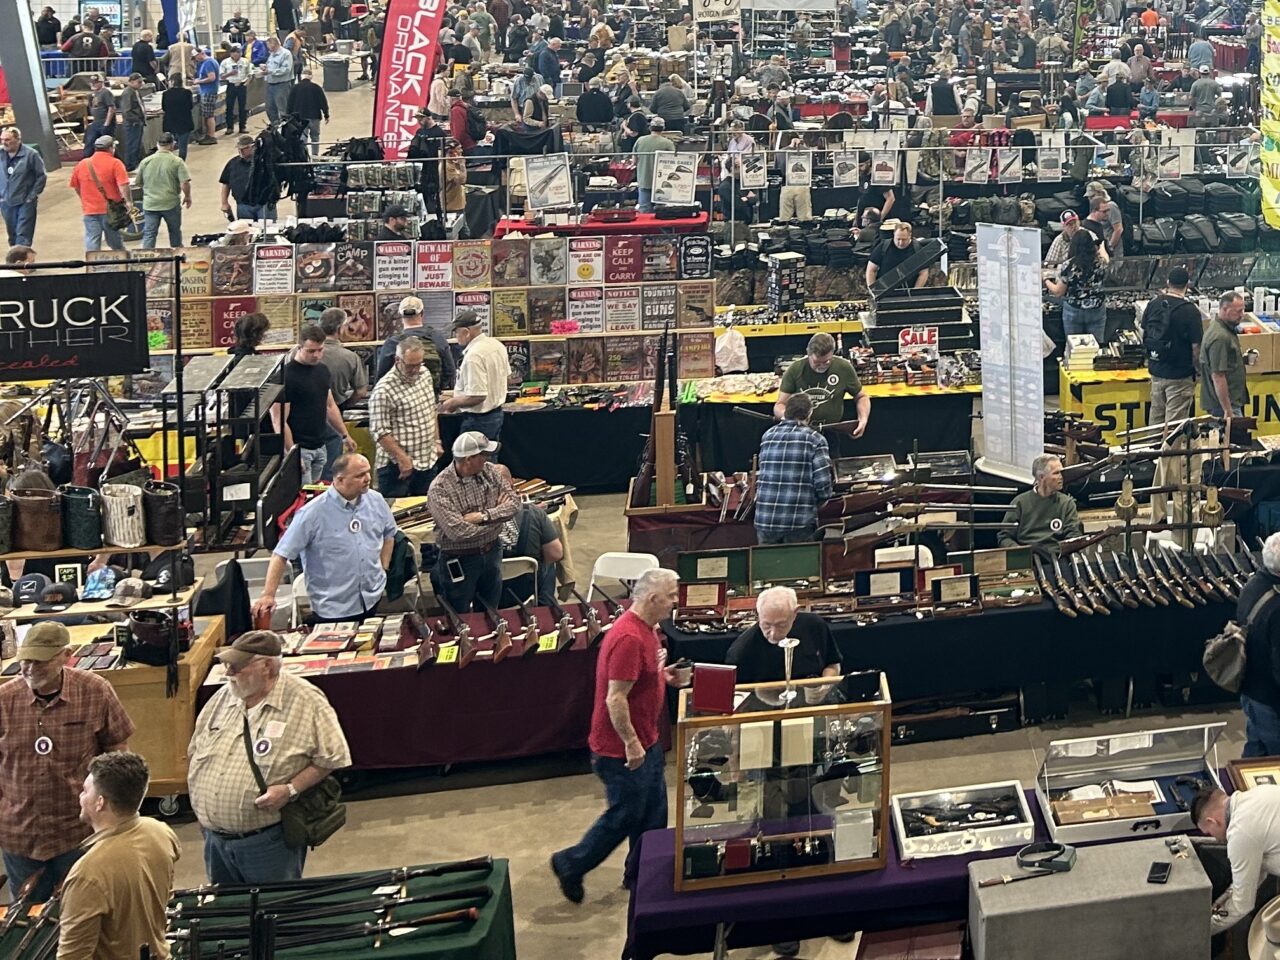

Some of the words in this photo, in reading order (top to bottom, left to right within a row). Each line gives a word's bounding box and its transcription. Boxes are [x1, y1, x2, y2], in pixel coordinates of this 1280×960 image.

[383, 15, 411, 149] ORDNANCE
[397, 103, 419, 158] RAI
[337, 244, 352, 253] OUR
[378, 244, 410, 254] WARNING
[419, 244, 452, 253] BEWARE
[571, 240, 601, 249] WARNING
[259, 247, 291, 258] WARNING
[337, 247, 368, 263] CAMP
[612, 248, 634, 256] KEEP
[429, 254, 441, 262] OF
[612, 257, 634, 265] CALM
[181, 275, 208, 285] UNSHINE
[609, 272, 637, 280] CARRY
[387, 279, 410, 287] religion
[181, 285, 208, 295] WATER
[571, 290, 602, 298] WARNING
[643, 289, 676, 297] COUNTRY
[457, 293, 488, 302] WARNING
[223, 310, 247, 319] KEEP
[645, 304, 675, 316] GUNS
[900, 328, 937, 346] SALE
